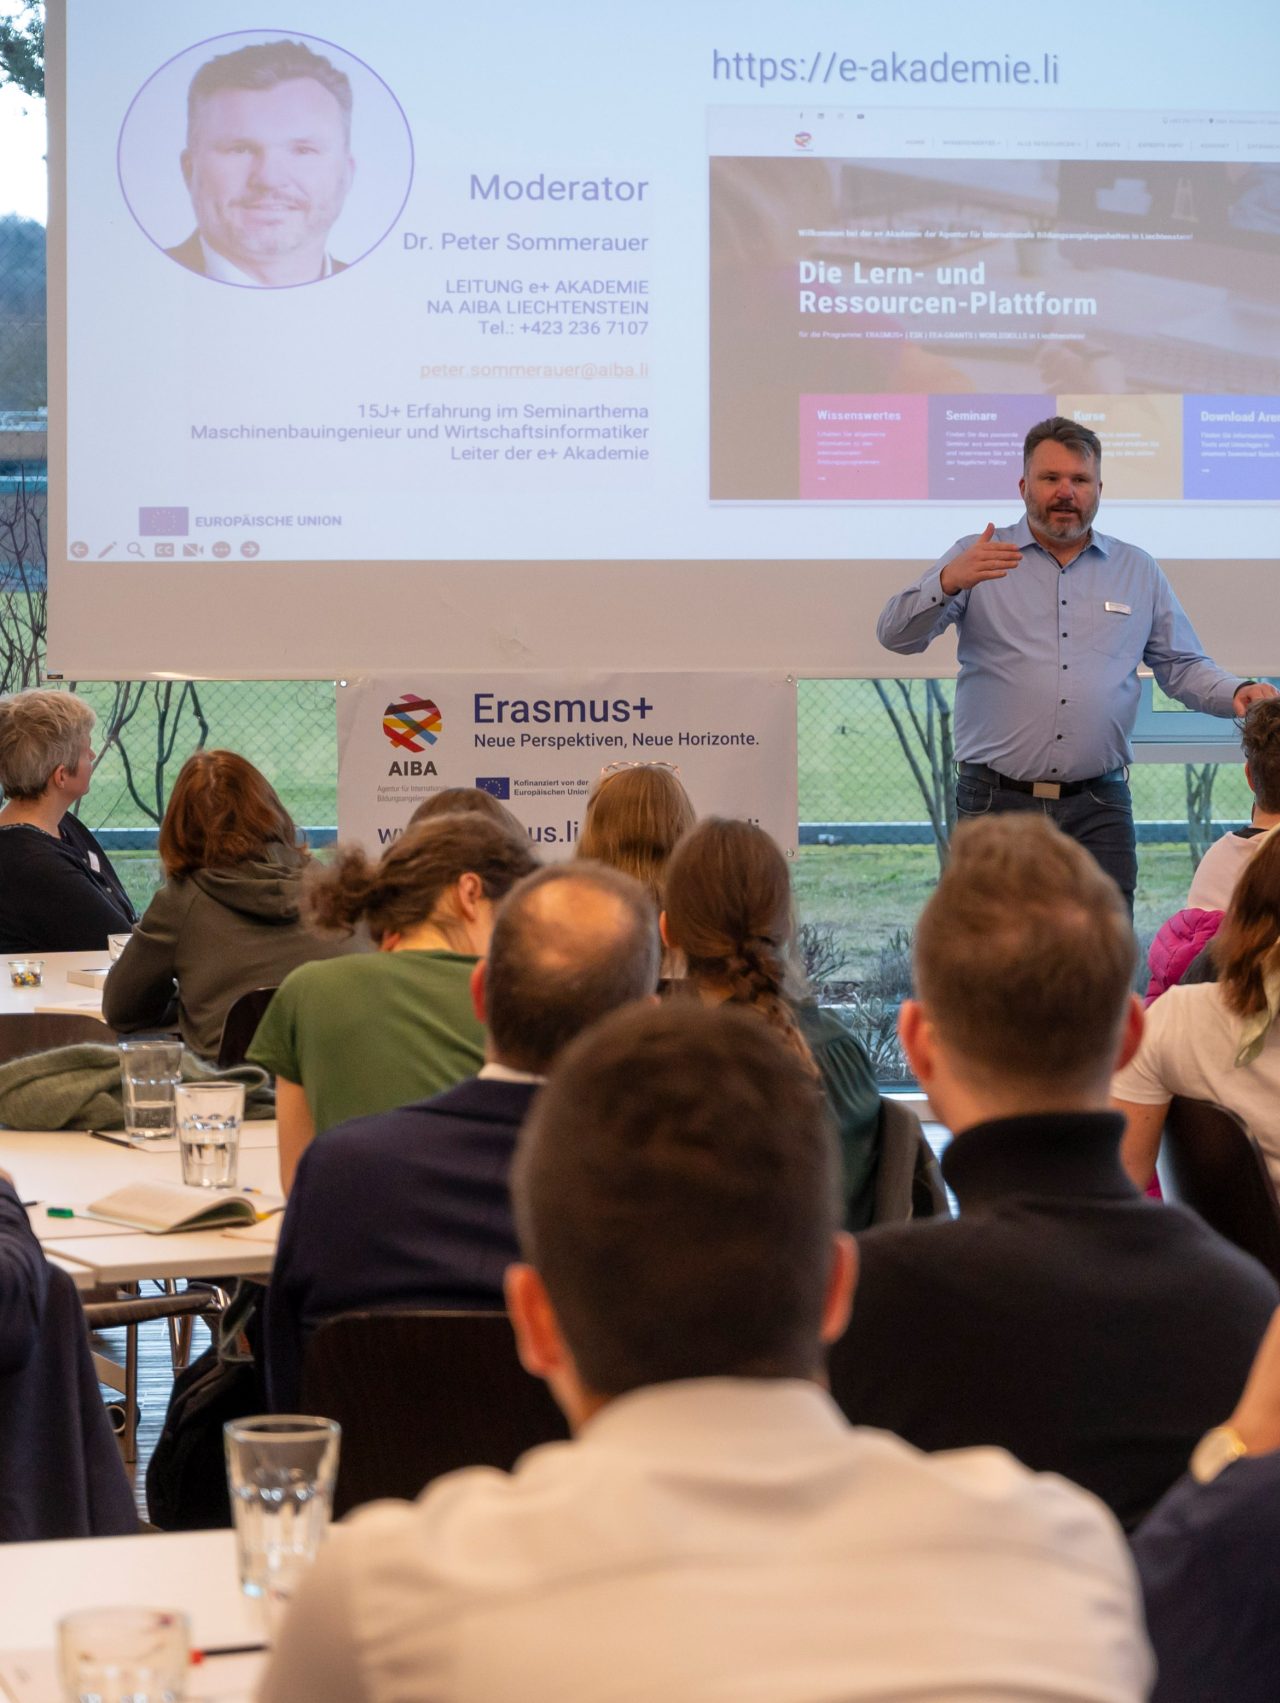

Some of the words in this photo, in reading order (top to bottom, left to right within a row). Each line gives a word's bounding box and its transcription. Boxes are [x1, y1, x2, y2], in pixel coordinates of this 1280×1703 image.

[713, 48, 1059, 88] https://e-akademie.li
[470, 173, 649, 201] Moderator
[403, 232, 432, 250] Dr.
[441, 232, 500, 250] Peter
[506, 232, 649, 252] Sommerauer
[799, 260, 842, 285] Die
[854, 260, 925, 285] Lern-
[937, 261, 985, 285] und
[446, 280, 523, 294] LEITUNG
[529, 282, 550, 294] e+
[555, 280, 649, 294] AKADEMIE
[427, 300, 453, 314] NA
[459, 300, 500, 315] AIBA
[506, 300, 649, 315] LIECHTENSTEIN
[799, 290, 1097, 315] Ressourcen-Plattform
[479, 320, 514, 335] Tel.:
[519, 321, 563, 335] +423
[568, 321, 601, 335] 236
[606, 321, 649, 335] 7107
[419, 362, 649, 380] peter.sommerauer@aiba.li
[358, 403, 400, 419] 15J+
[407, 403, 491, 421] Erfahrung
[497, 403, 518, 418] im
[523, 403, 649, 419] Seminarthema
[817, 410, 902, 421] Wissenswertes
[945, 410, 998, 421] Seminare
[1073, 410, 1106, 422] Kurse
[1200, 411, 1255, 422] Download
[190, 424, 401, 442] Maschinenbauingenieur
[407, 424, 439, 440] und
[445, 424, 649, 440] Wirtschaftsinformatiker
[451, 446, 498, 460] Leiter
[504, 446, 532, 460] der
[537, 449, 558, 460] e+
[563, 446, 649, 461] Akademie
[194, 514, 293, 527] EUROPÄISCHE
[297, 515, 342, 527] UNION
[474, 693, 654, 724] Erasmus+
[474, 733, 516, 747] Neue
[520, 733, 628, 750] Perspektiven,
[632, 732, 673, 746] Neue
[678, 732, 760, 747] Horizonte.
[388, 761, 438, 776] AIBA
[377, 785, 400, 793] Agentur
[514, 788, 566, 797] Europäischen
[377, 794, 425, 803] Bildungsangeleg
